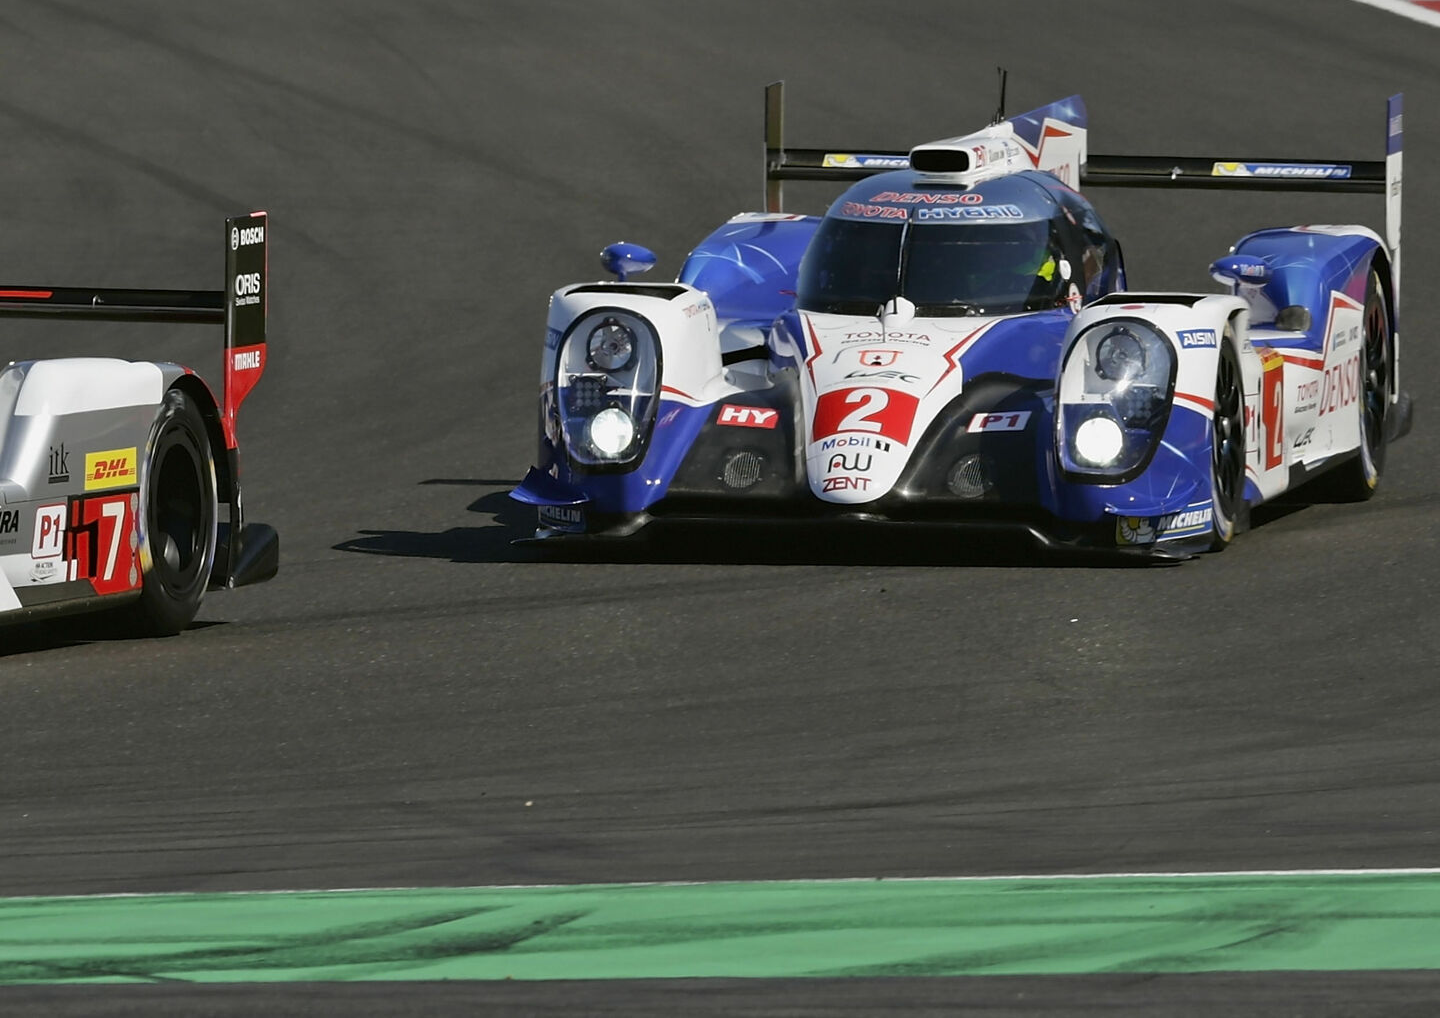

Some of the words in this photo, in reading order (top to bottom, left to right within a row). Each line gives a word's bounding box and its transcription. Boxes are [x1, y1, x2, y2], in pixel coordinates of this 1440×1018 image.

[1254, 167, 1349, 178] MICHELIN
[870, 191, 984, 205] DENSO
[918, 203, 1024, 219] HYBRID
[240, 226, 264, 245] BOSCH
[235, 272, 260, 296] ORIS
[843, 331, 932, 342] TOYOTA
[1182, 332, 1216, 346] AISIN
[234, 350, 260, 371] MAHLE
[1317, 354, 1360, 417] DENSO
[721, 407, 773, 424] HY
[837, 387, 890, 433] 2
[979, 413, 1021, 429] P1
[821, 435, 870, 451] Mobil
[49, 443, 70, 475] itk
[93, 457, 129, 481] DHL
[823, 477, 872, 494] ZENT
[38, 514, 61, 550] P1
[101, 500, 126, 582] 7
